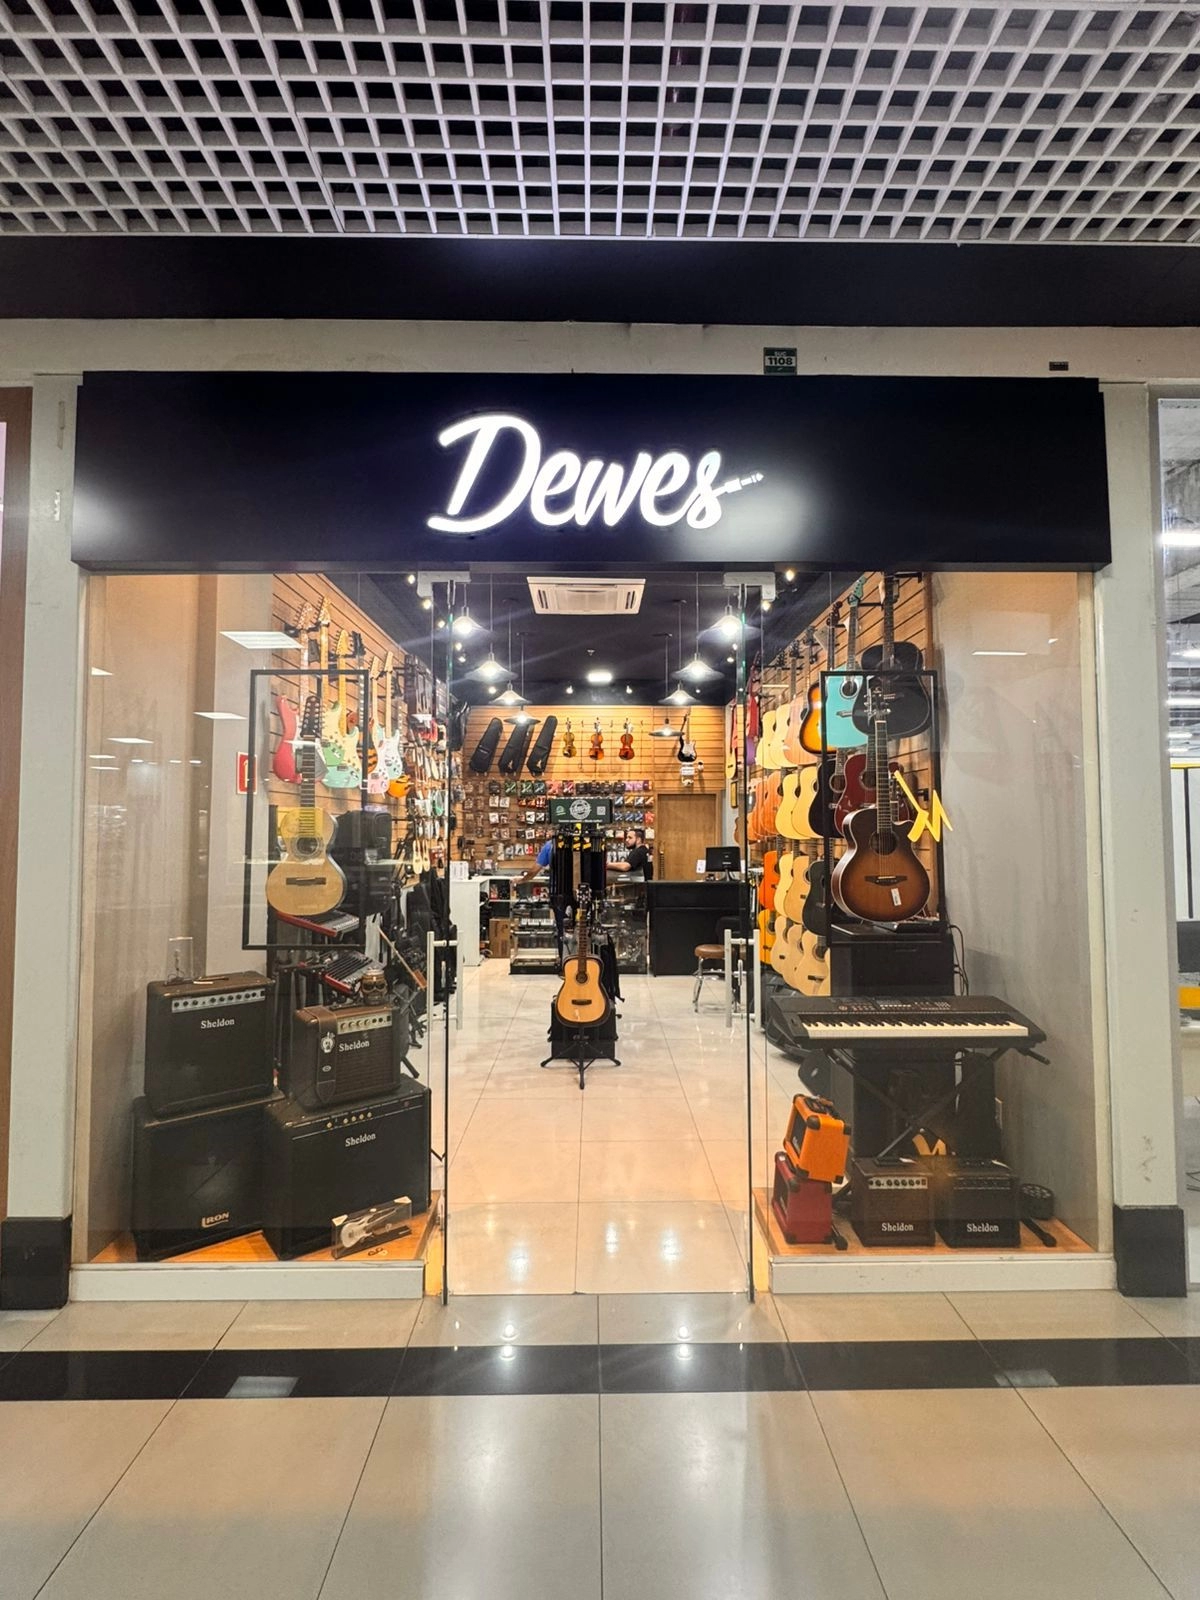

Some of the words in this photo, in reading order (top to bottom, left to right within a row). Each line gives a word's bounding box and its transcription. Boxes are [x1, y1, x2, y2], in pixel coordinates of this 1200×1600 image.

[767, 357, 793, 366] 1108
[427, 414, 722, 533] Dewes
[200, 1018, 235, 1030] Sheldon
[339, 1040, 370, 1052] Sheldon
[345, 1133, 376, 1147] Sheldon
[881, 1222, 914, 1232] Sheldon
[966, 1222, 999, 1232] Sheldon
